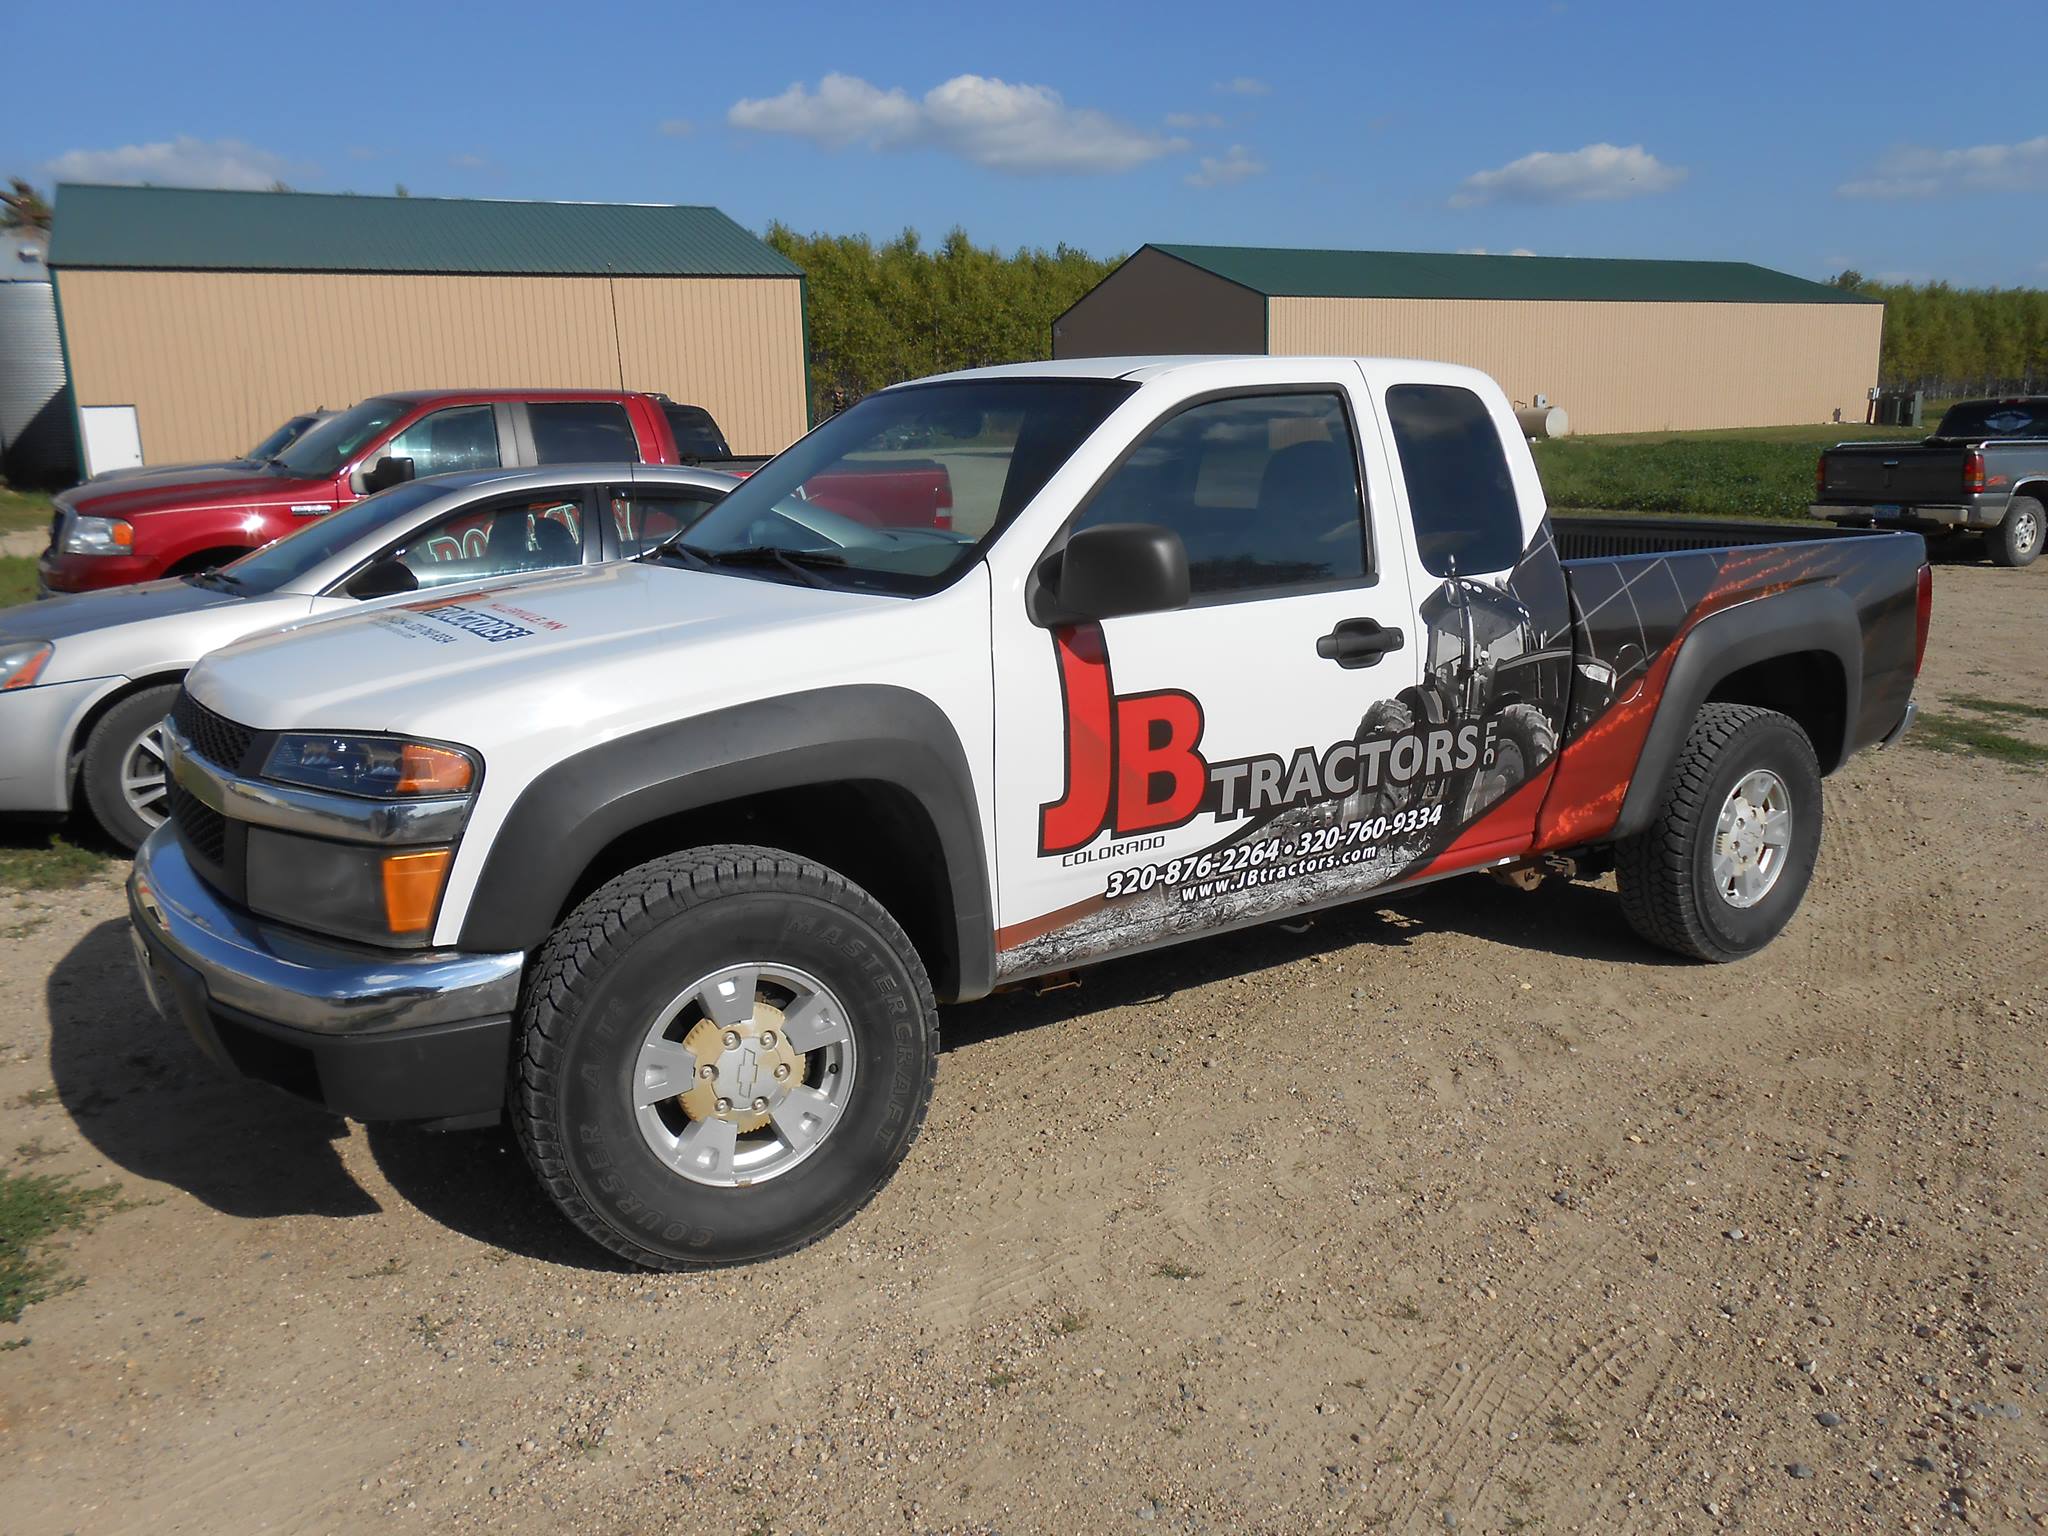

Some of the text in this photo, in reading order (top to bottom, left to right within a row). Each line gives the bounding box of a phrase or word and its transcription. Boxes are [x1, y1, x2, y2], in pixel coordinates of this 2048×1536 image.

[1038, 621, 1498, 857] JB TRACTORS LLC
[1062, 835, 1165, 868] COLORADO
[1105, 804, 1443, 899] 320-876-2264 320-760-9334
[1181, 844, 1377, 901] www.JBtractors.com
[784, 915, 914, 1150] MASTERCRAFT
[579, 1121, 717, 1248] COURSER
